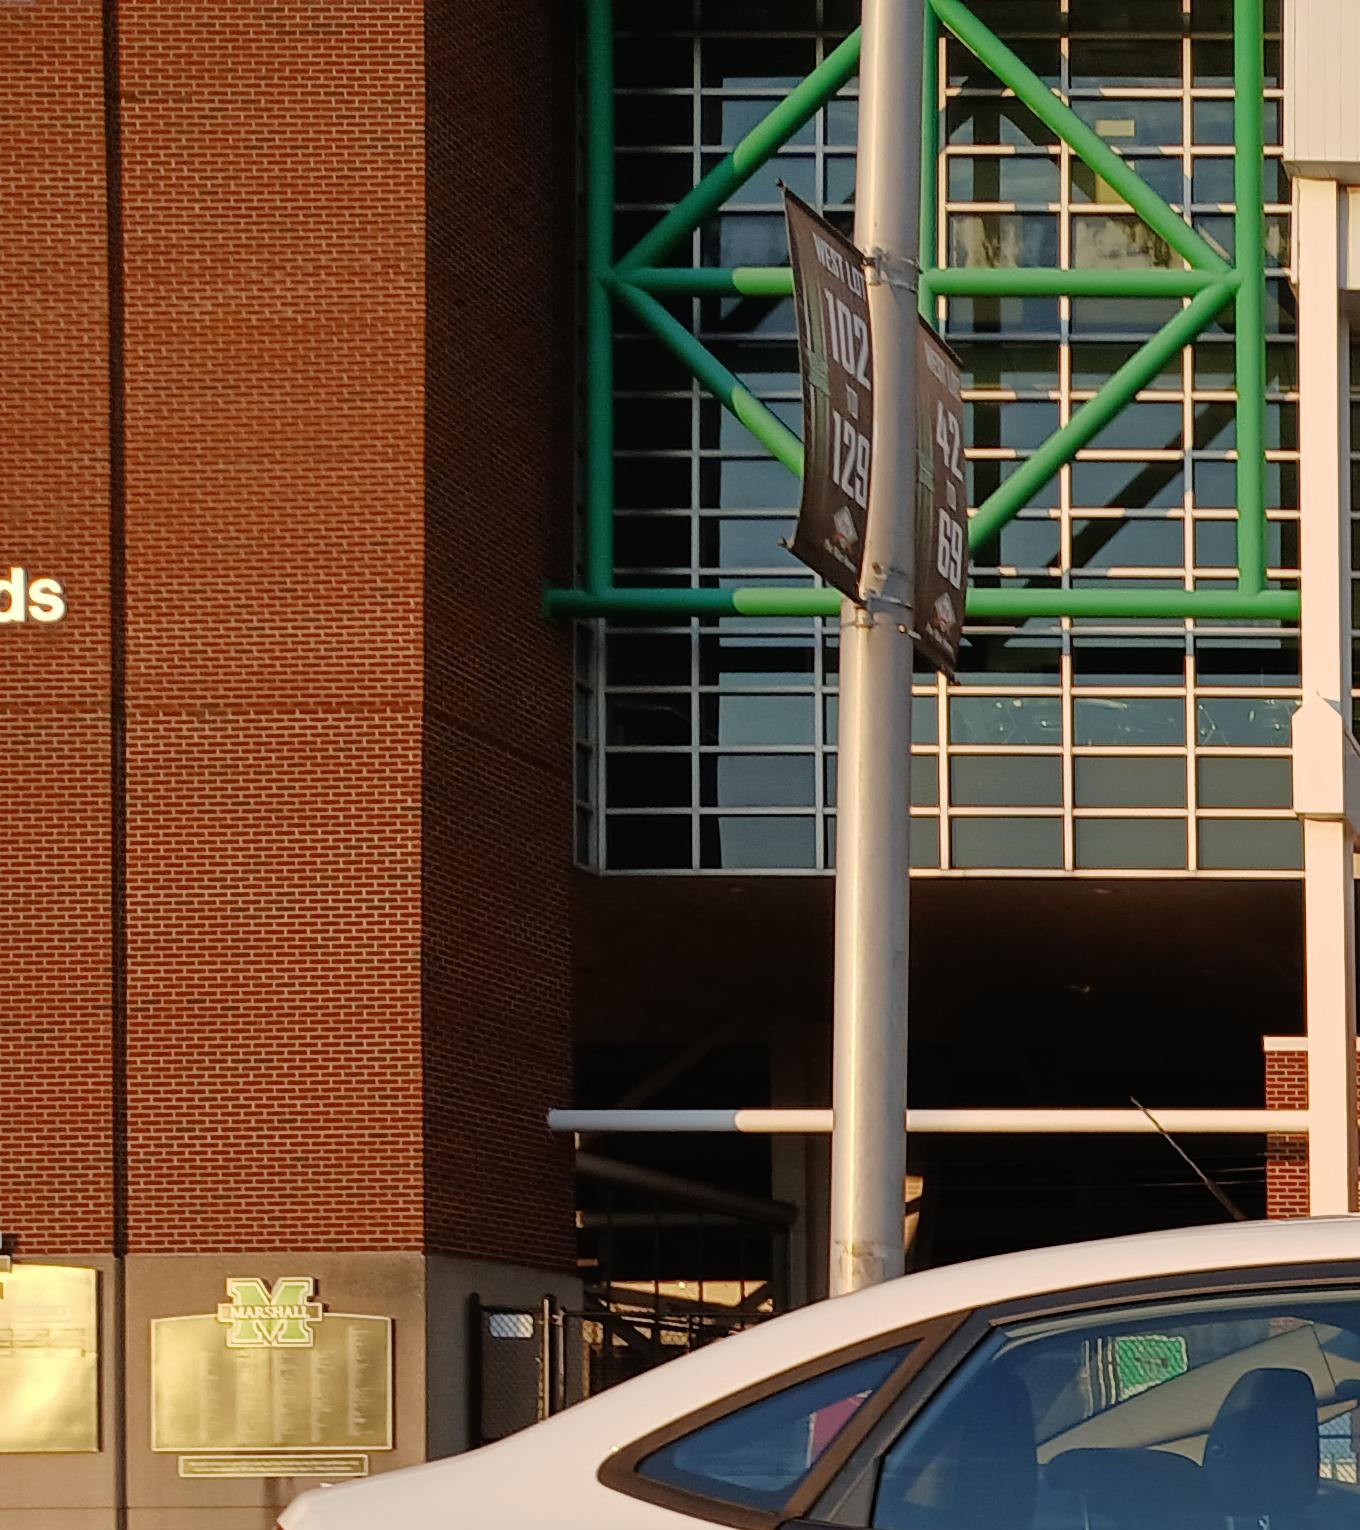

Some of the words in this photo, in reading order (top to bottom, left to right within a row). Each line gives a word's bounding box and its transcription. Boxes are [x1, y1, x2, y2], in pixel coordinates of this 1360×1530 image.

[812, 231, 845, 284] WEST
[824, 288, 871, 391] 102
[833, 408, 870, 510] 129
[936, 400, 963, 482] 42
[937, 507, 963, 591] 69
[230, 1306, 310, 1319] MARSHALL
